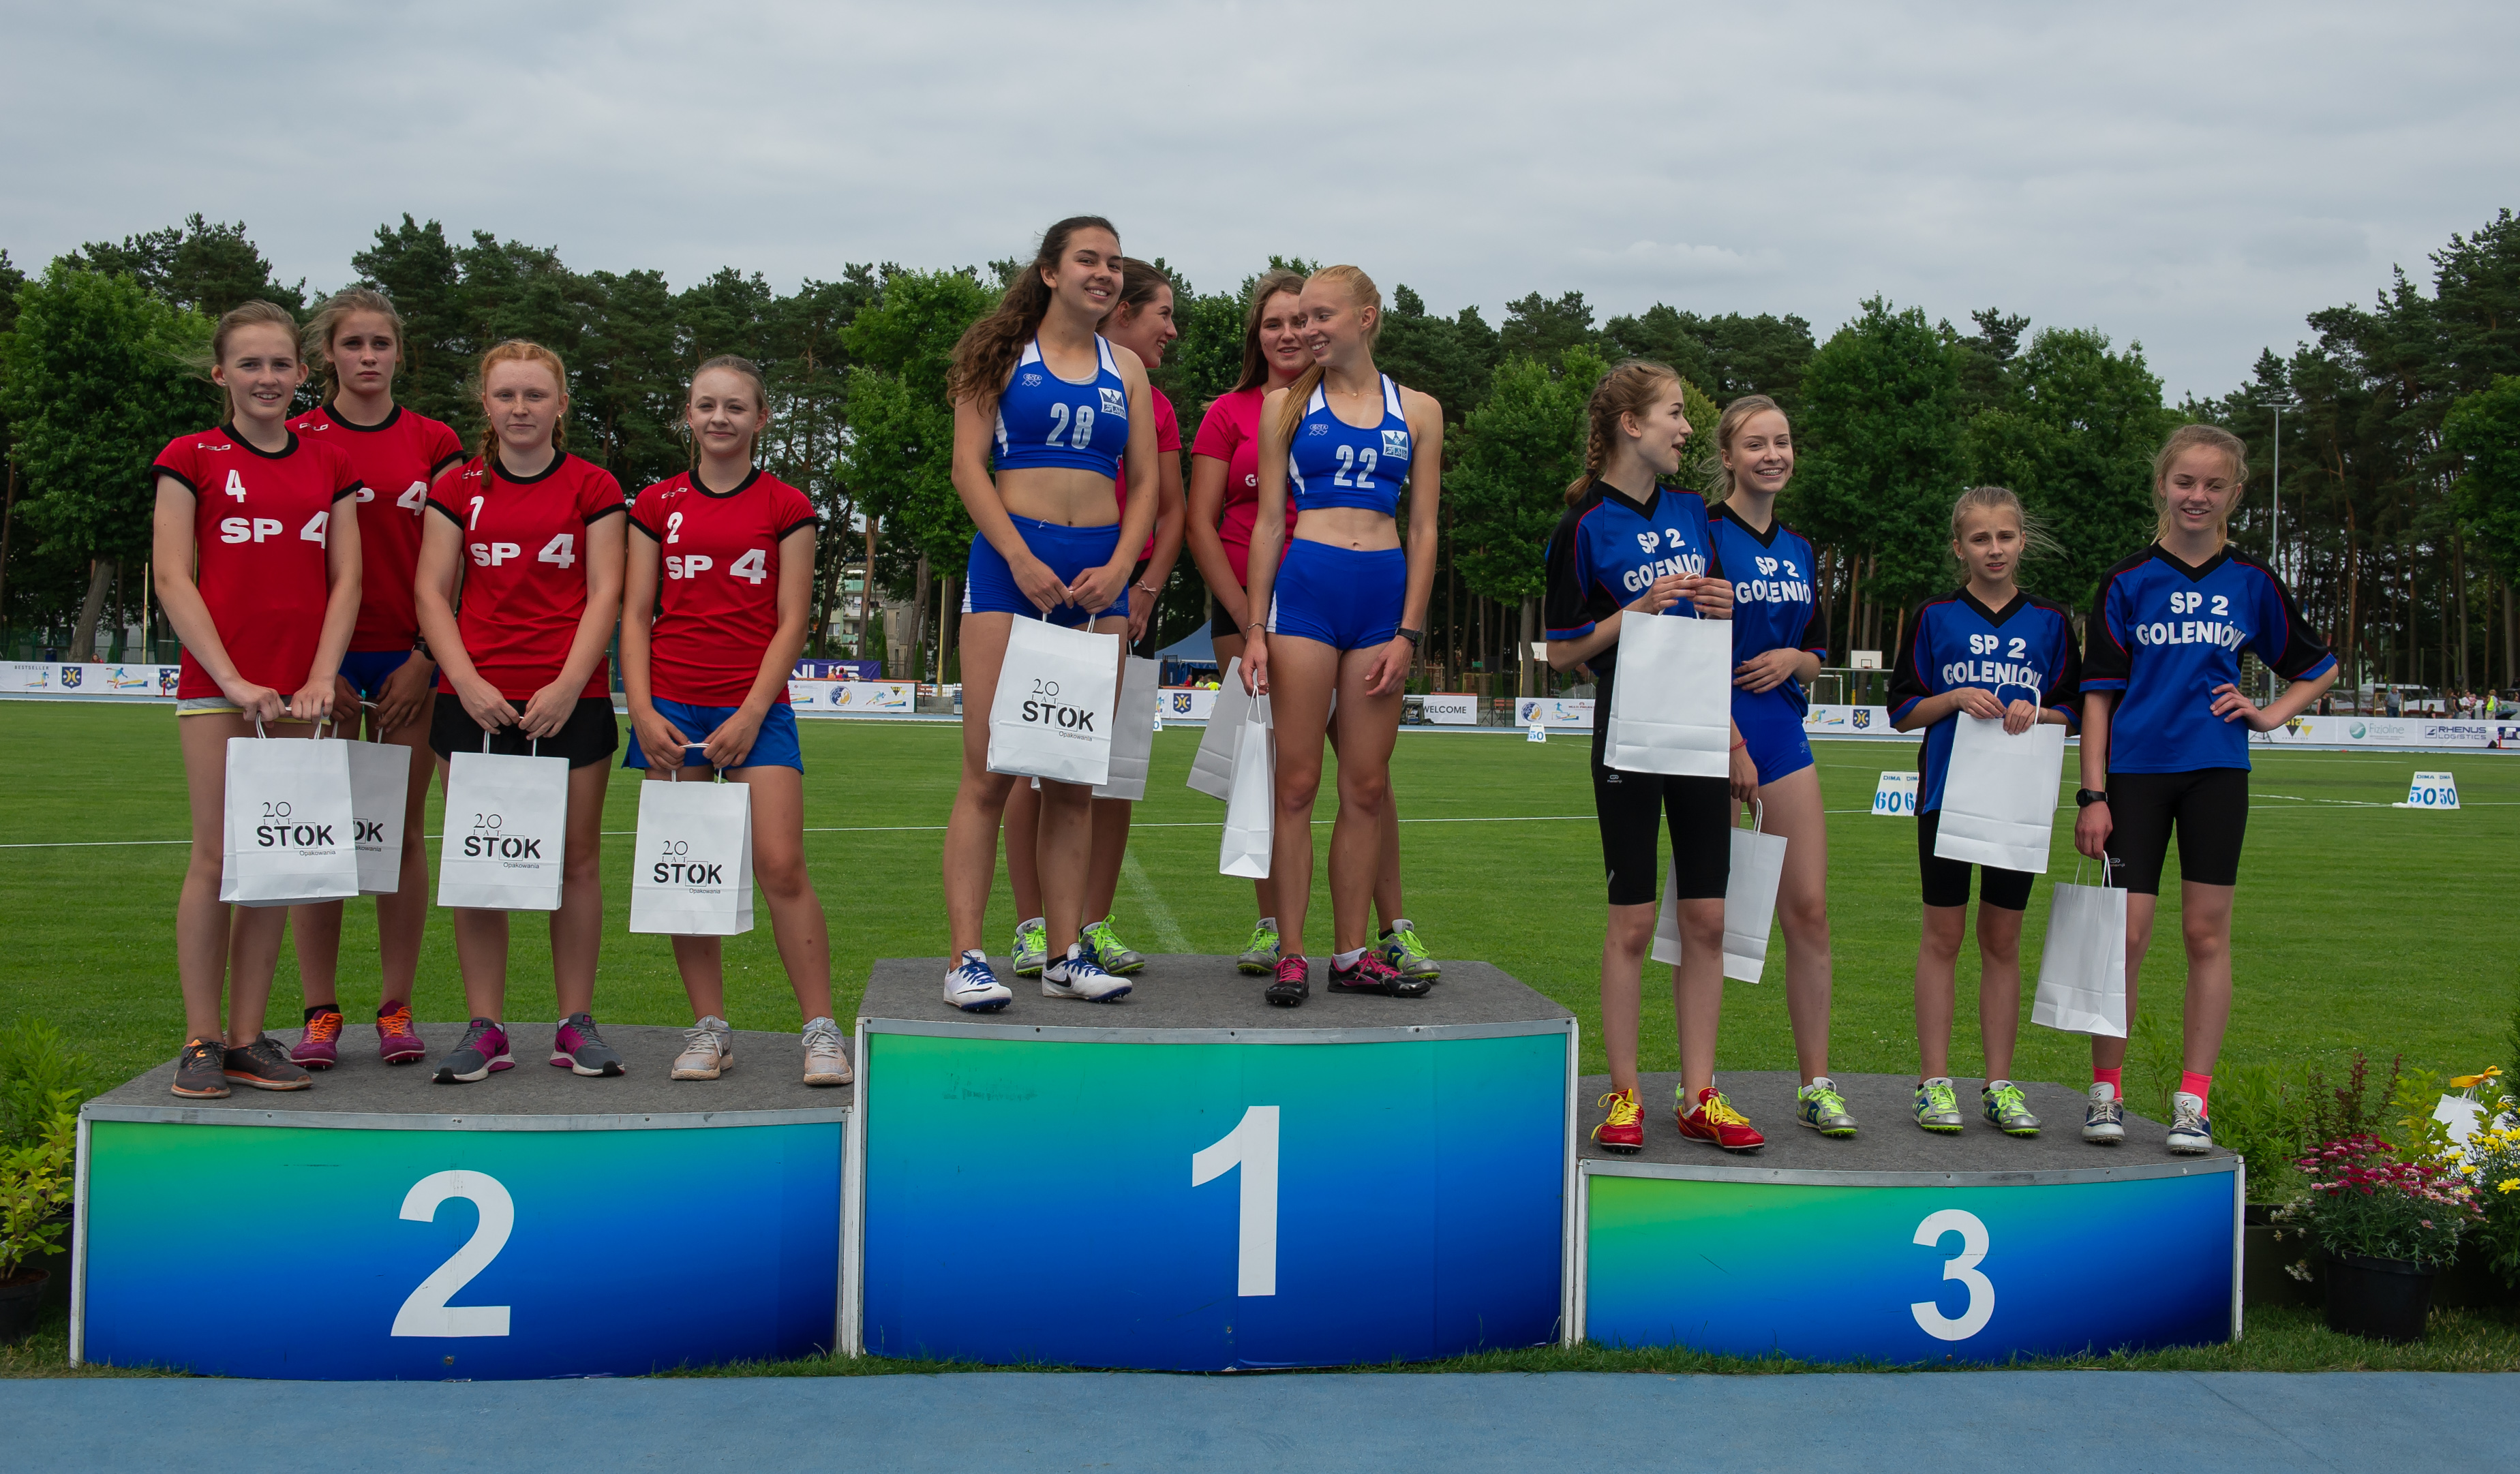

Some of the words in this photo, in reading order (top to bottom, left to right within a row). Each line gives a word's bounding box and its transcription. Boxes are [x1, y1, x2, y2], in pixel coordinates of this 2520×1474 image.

[1046, 403, 1094, 449] 28
[1334, 444, 1377, 488] 22
[226, 470, 246, 503] 4
[397, 480, 427, 516] 4
[220, 517, 283, 543] SP
[300, 510, 329, 549] 4
[667, 512, 683, 544] 2
[470, 542, 521, 566] SP
[538, 534, 575, 568] 4
[1637, 532, 1660, 553] SP
[1665, 528, 1686, 548] 2
[666, 555, 713, 579] SP
[729, 549, 767, 584] 4
[1755, 556, 1778, 577] SP
[1782, 560, 1800, 578] 2
[2170, 592, 2202, 614] SP
[2211, 595, 2228, 616] 2
[1970, 634, 1999, 655] SP
[2007, 637, 2026, 659] 2
[1032, 678, 1059, 696] 20
[1031, 694, 1058, 704] LAT
[1423, 705, 1467, 714] WELCOME
[1022, 701, 1094, 732] STOK
[1059, 731, 1092, 741] Opakowania
[1530, 731, 1544, 740] 50
[2369, 723, 2405, 734] Fizjoline
[1875, 791, 1901, 813] 60
[1904, 792, 1917, 811] 6
[2410, 786, 2436, 805] 50
[2440, 788, 2456, 805] 50
[262, 801, 292, 818] 20
[473, 813, 502, 829] 20
[257, 825, 335, 846] STOK
[464, 835, 541, 859] STOK
[662, 840, 688, 855] 20
[654, 863, 723, 885] STOK
[1192, 1105, 1279, 1296] 1
[391, 1170, 515, 1337] 2
[1911, 1209, 1995, 1341] 3
